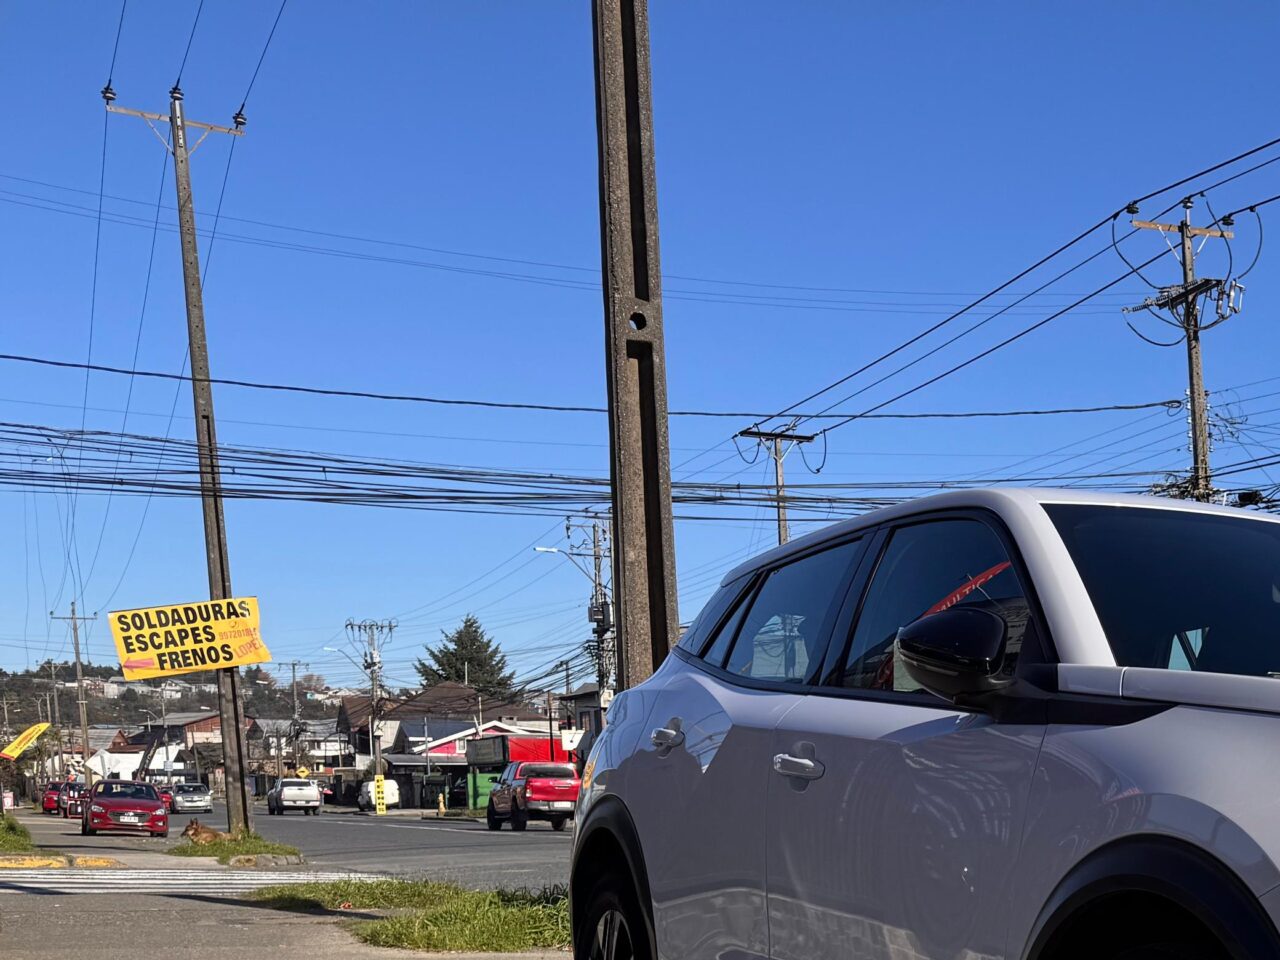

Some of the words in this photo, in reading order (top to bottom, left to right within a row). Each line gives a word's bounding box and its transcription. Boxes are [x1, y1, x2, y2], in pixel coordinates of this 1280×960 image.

[117, 600, 251, 633] SOLDADURAS
[122, 625, 216, 654] ESCAPES
[156, 644, 234, 671] FRENOS
